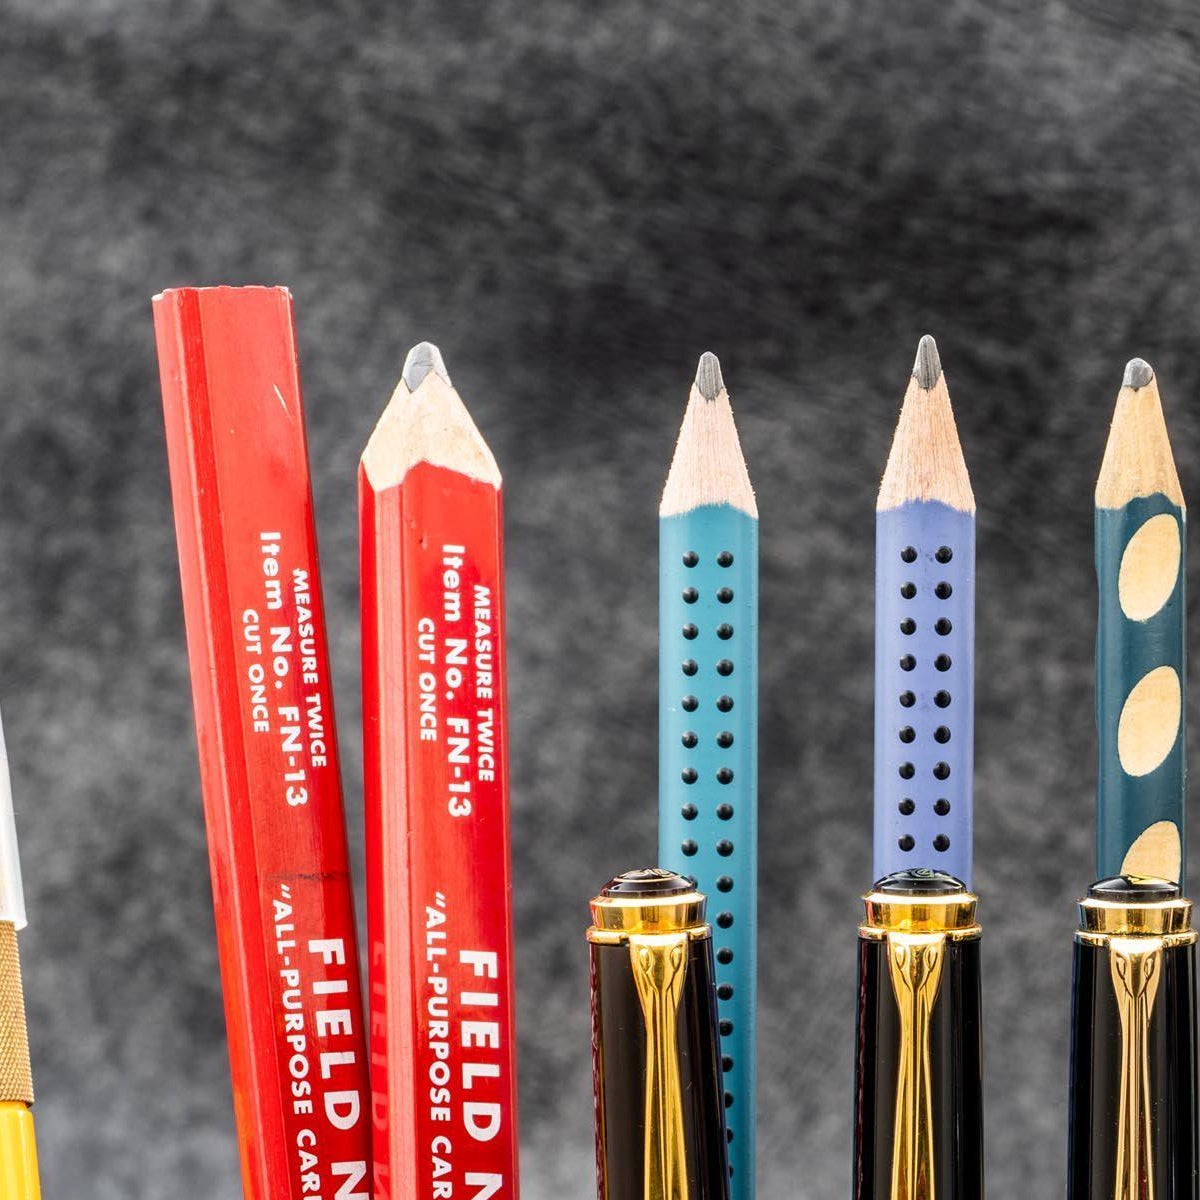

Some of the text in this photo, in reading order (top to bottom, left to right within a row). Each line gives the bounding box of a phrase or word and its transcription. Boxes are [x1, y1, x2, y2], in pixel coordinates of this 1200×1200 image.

[240, 608, 270, 733] CUT ONCE
[258, 531, 308, 807] Item No. FN-13
[292, 568, 326, 767] MEASURE TWICE
[414, 617, 437, 742] CUT ONCE
[442, 544, 472, 817] Item No. FN-13
[474, 585, 494, 781] MEASURE TWICE
[308, 939, 360, 1129] FIELD
[459, 949, 501, 1141] FIELD
